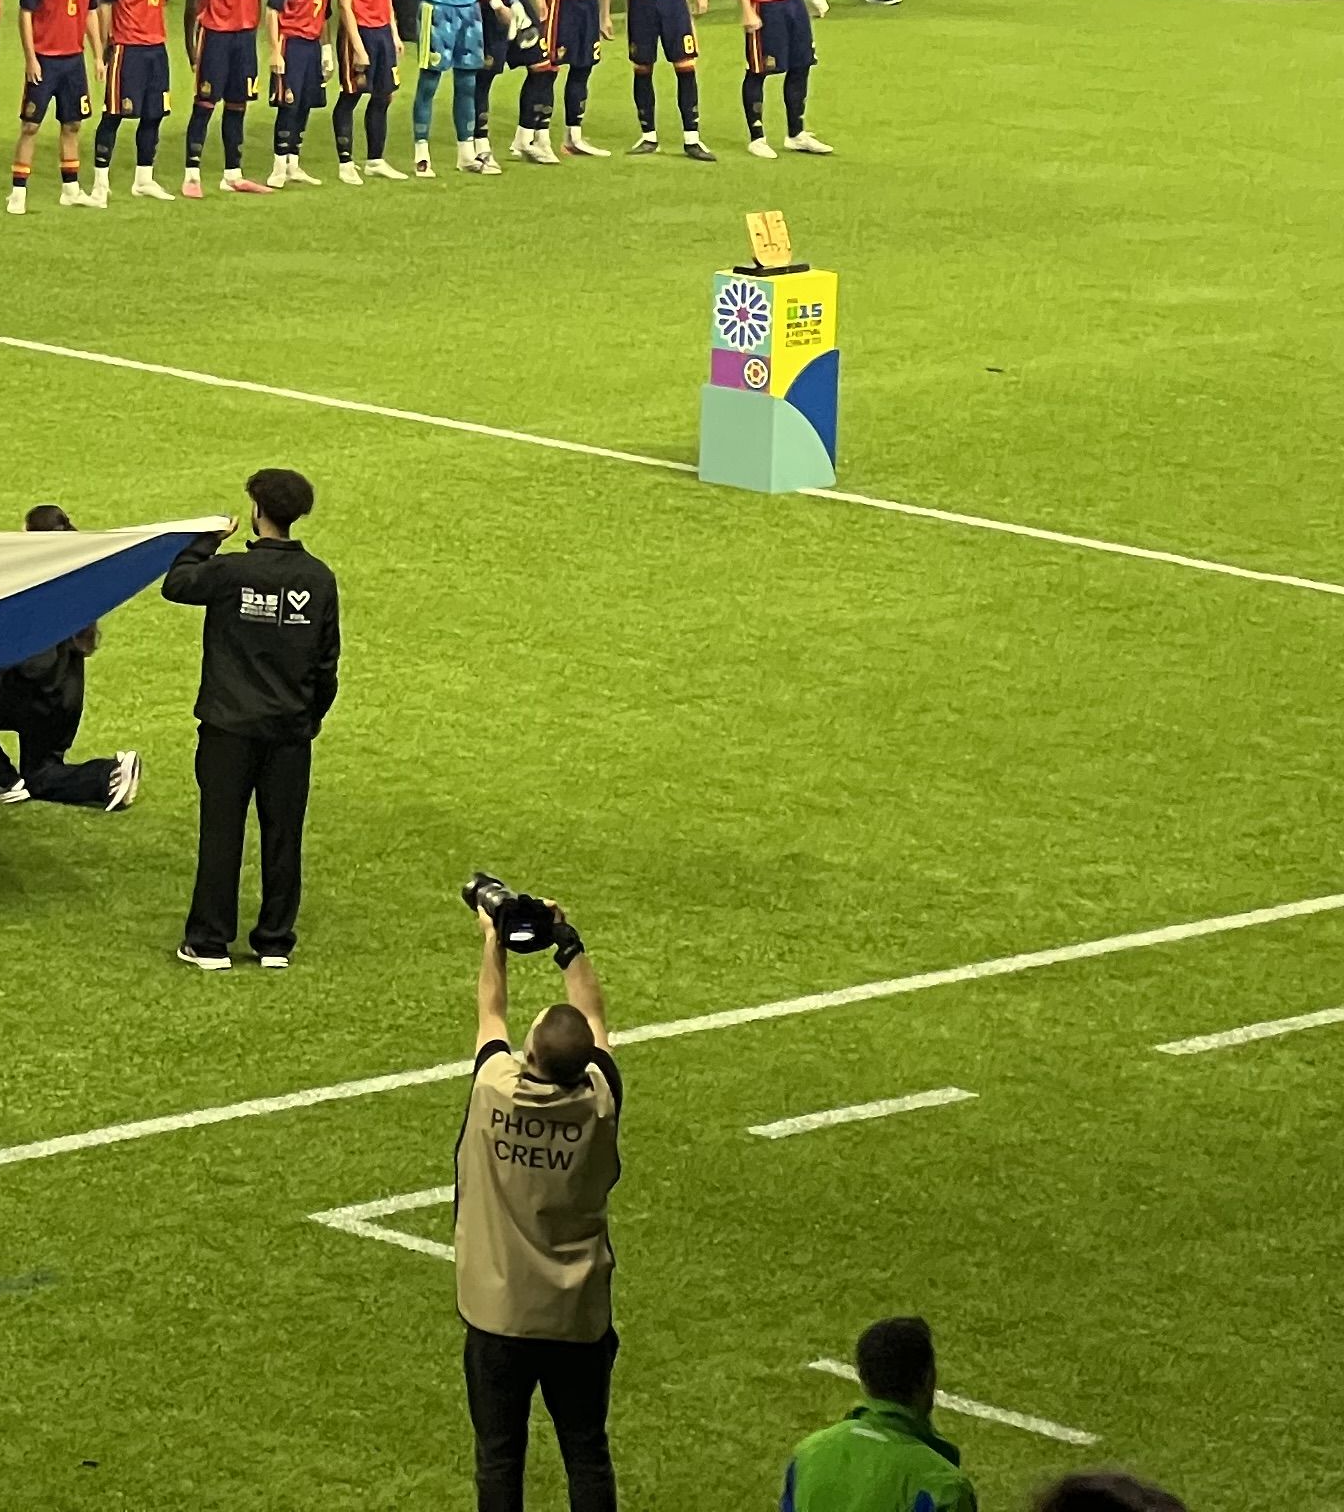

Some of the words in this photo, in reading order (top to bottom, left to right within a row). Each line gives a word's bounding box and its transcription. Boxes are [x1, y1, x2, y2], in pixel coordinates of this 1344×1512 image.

[593, 40, 601, 61] 2
[683, 34, 694, 55] 8
[80, 96, 90, 116] 6
[491, 1108, 582, 1142] PHOTO
[495, 1140, 574, 1171] CREW
